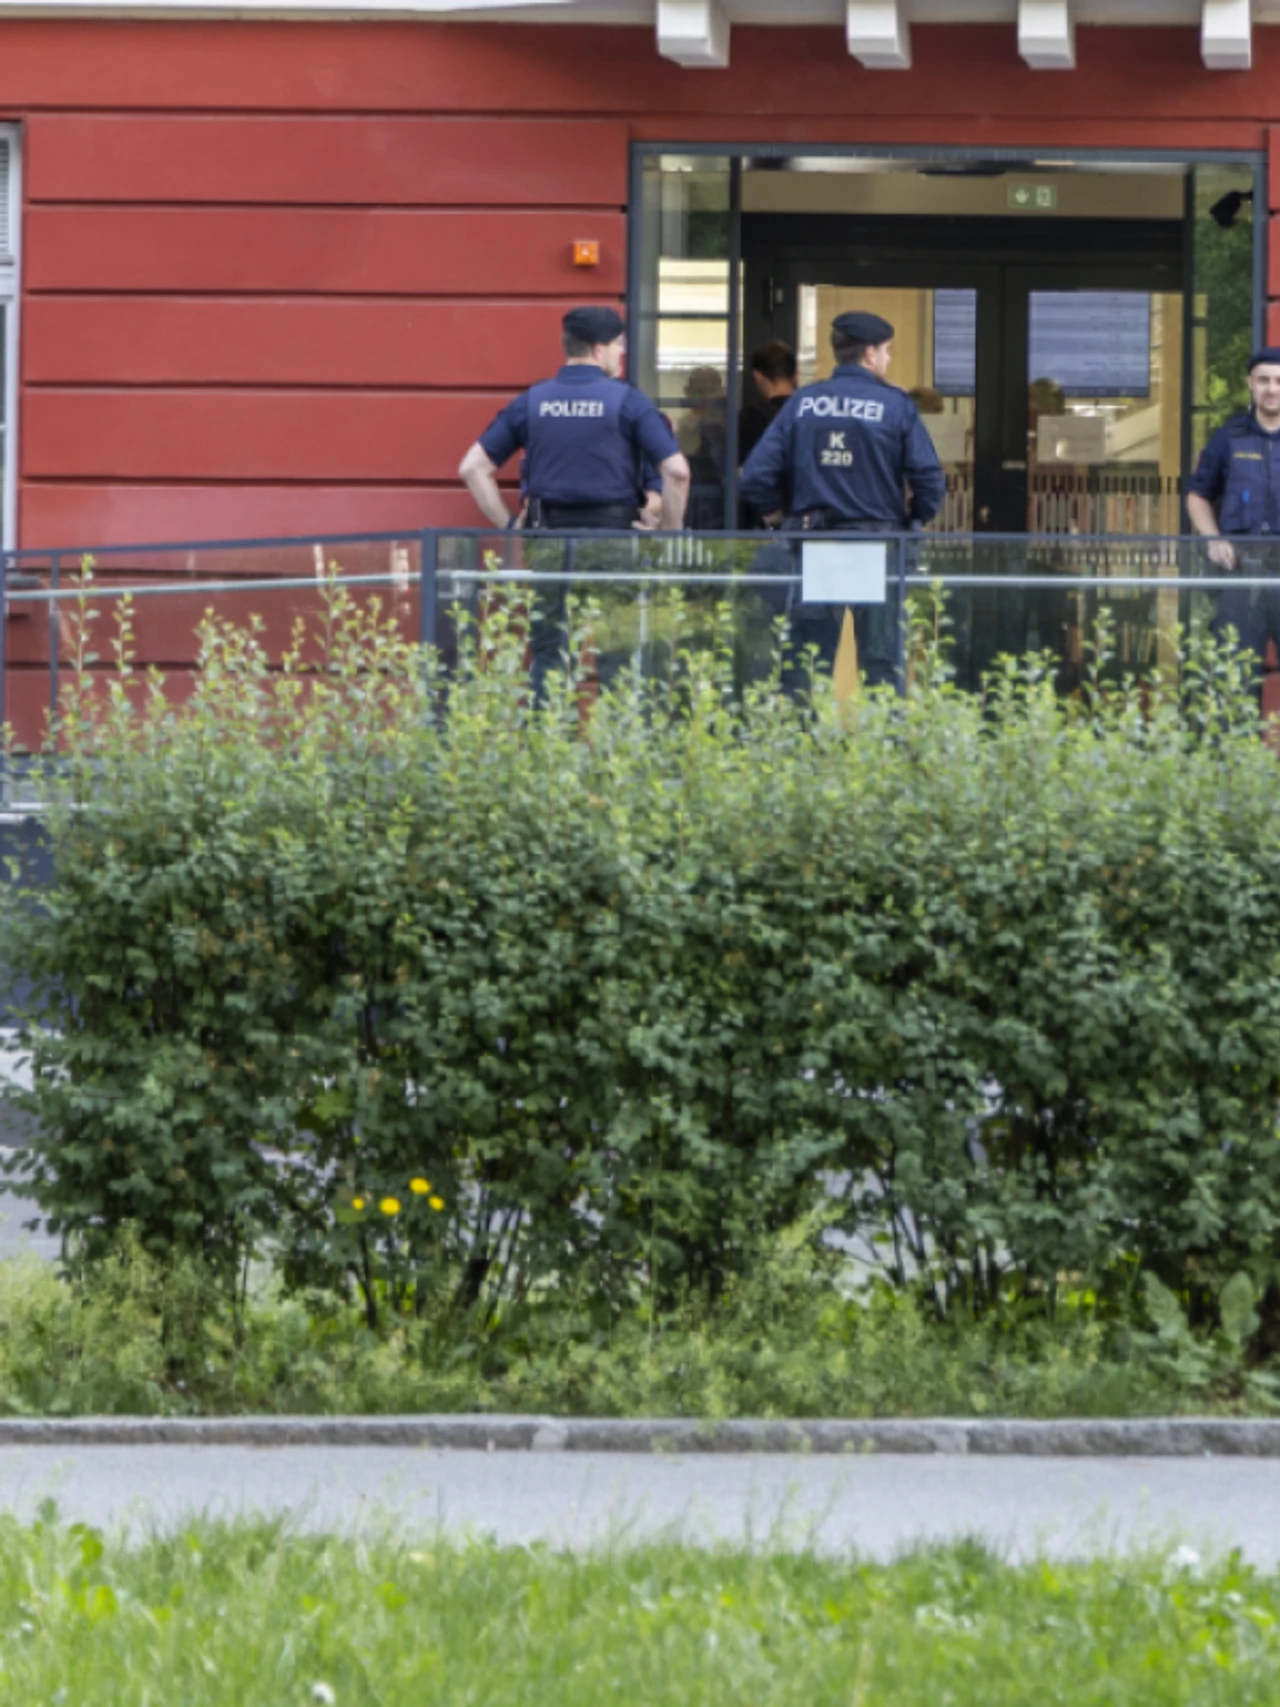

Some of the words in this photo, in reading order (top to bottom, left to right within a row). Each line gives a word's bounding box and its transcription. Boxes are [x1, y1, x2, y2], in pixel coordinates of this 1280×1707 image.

[540, 401, 604, 418] POLIZEI
[798, 396, 885, 422] POLIZEI
[830, 432, 845, 448] K
[821, 450, 853, 467] 220
